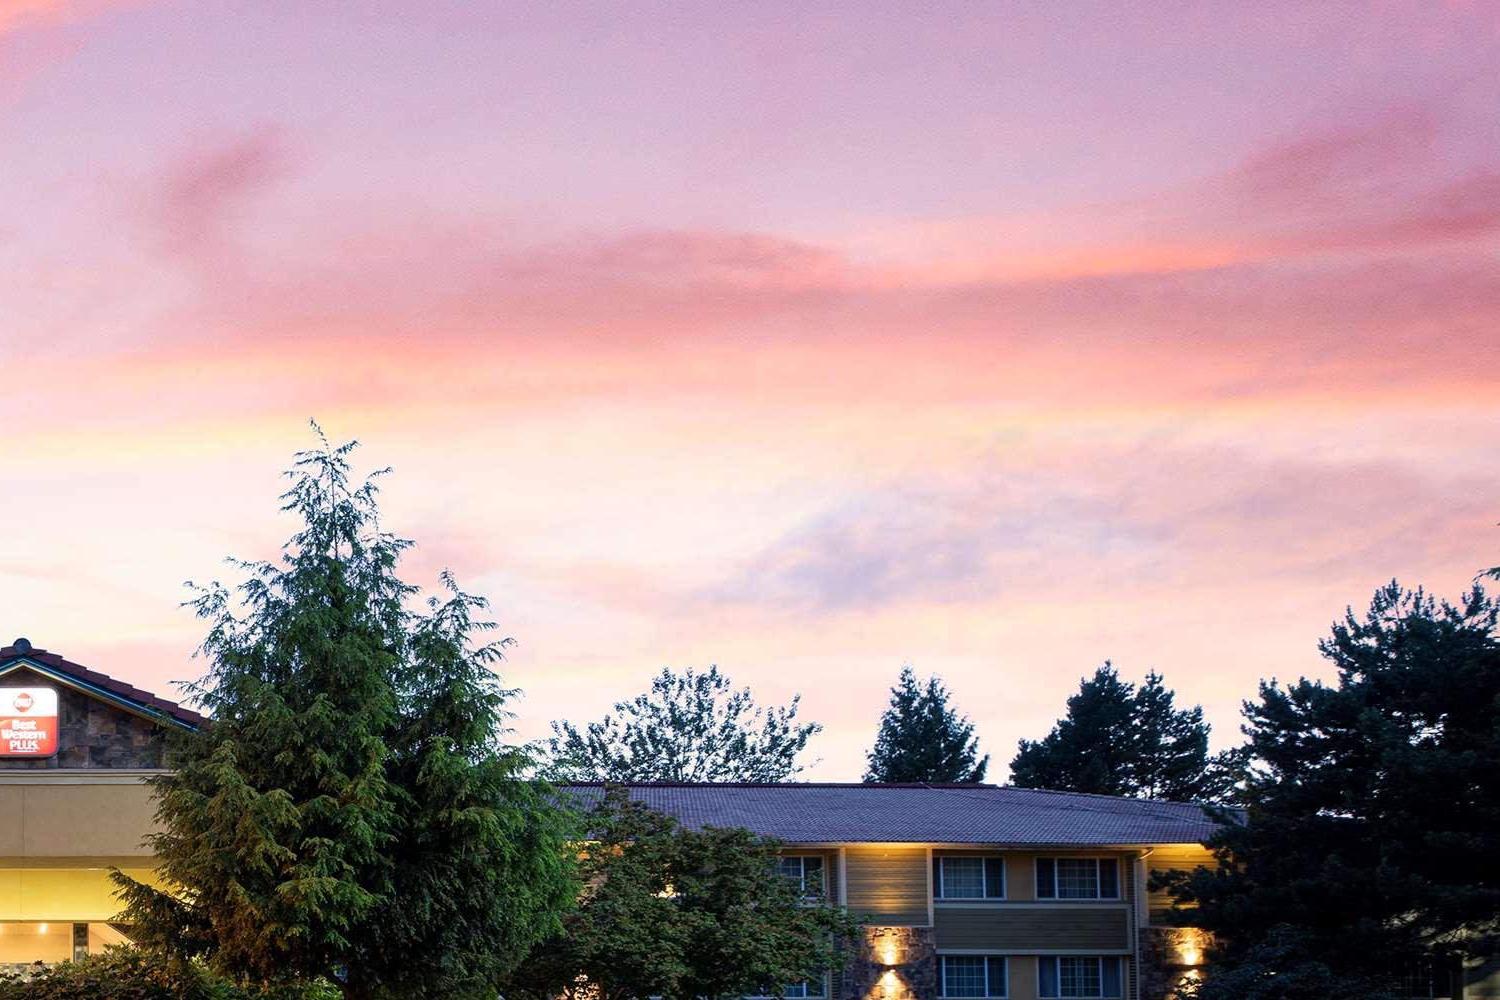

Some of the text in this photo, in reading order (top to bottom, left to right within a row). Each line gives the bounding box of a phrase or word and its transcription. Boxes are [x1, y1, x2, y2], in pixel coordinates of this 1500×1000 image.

[11, 719, 37, 730] Best
[1, 728, 47, 740] Western
[9, 740, 38, 750] PLUS
